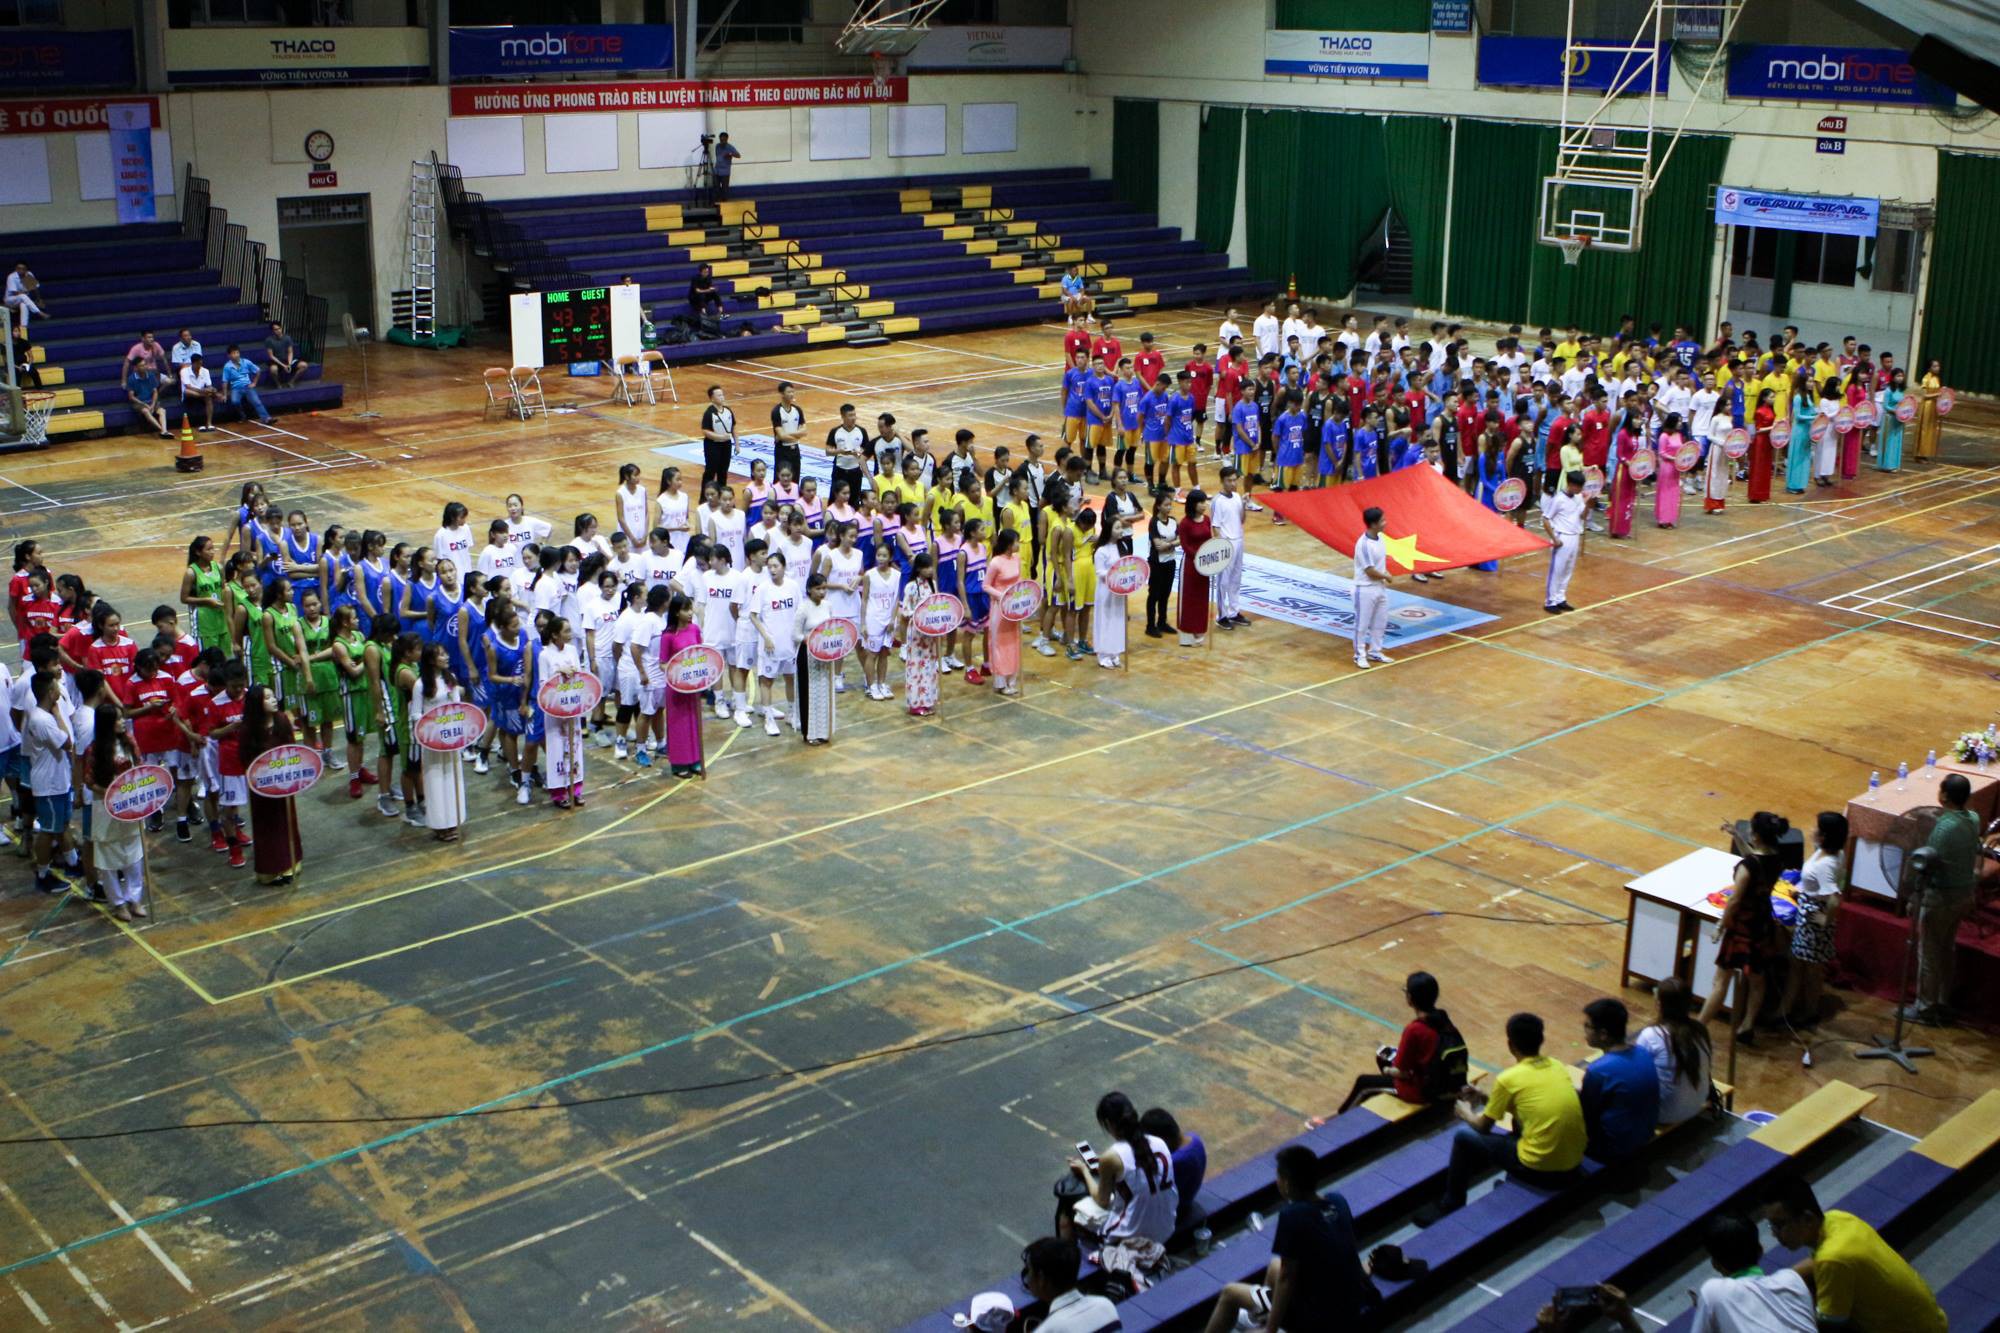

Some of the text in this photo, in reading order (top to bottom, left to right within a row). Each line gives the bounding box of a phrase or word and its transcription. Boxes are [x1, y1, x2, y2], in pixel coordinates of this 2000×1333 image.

[270, 40, 336, 53] THACO
[501, 31, 624, 56] mobifone
[1319, 36, 1372, 50] THACO
[336, 70, 349, 79] XA
[1768, 53, 1916, 83] mobifone
[523, 90, 550, 109] ỨNG
[554, 92, 595, 107] PHONG
[599, 88, 629, 106] TRÀO
[632, 87, 656, 105] RÈN
[659, 86, 696, 107] LUYỆN
[699, 85, 728, 103] THÂN
[754, 88, 780, 102] THEO
[783, 86, 820, 100] GƯƠNG
[823, 83, 844, 99] BÁC
[16, 104, 46, 128] TỔ
[1835, 120, 1844, 129] B
[1834, 141, 1842, 151] B
[311, 174, 335, 185] KHU C
[547, 288, 605, 304] HOME GUEST
[1680, 353, 1692, 366] 15
[1199, 551, 1219, 567] TRỌNG
[301, 767, 315, 779] MINH
[155, 786, 168, 801] MINH
